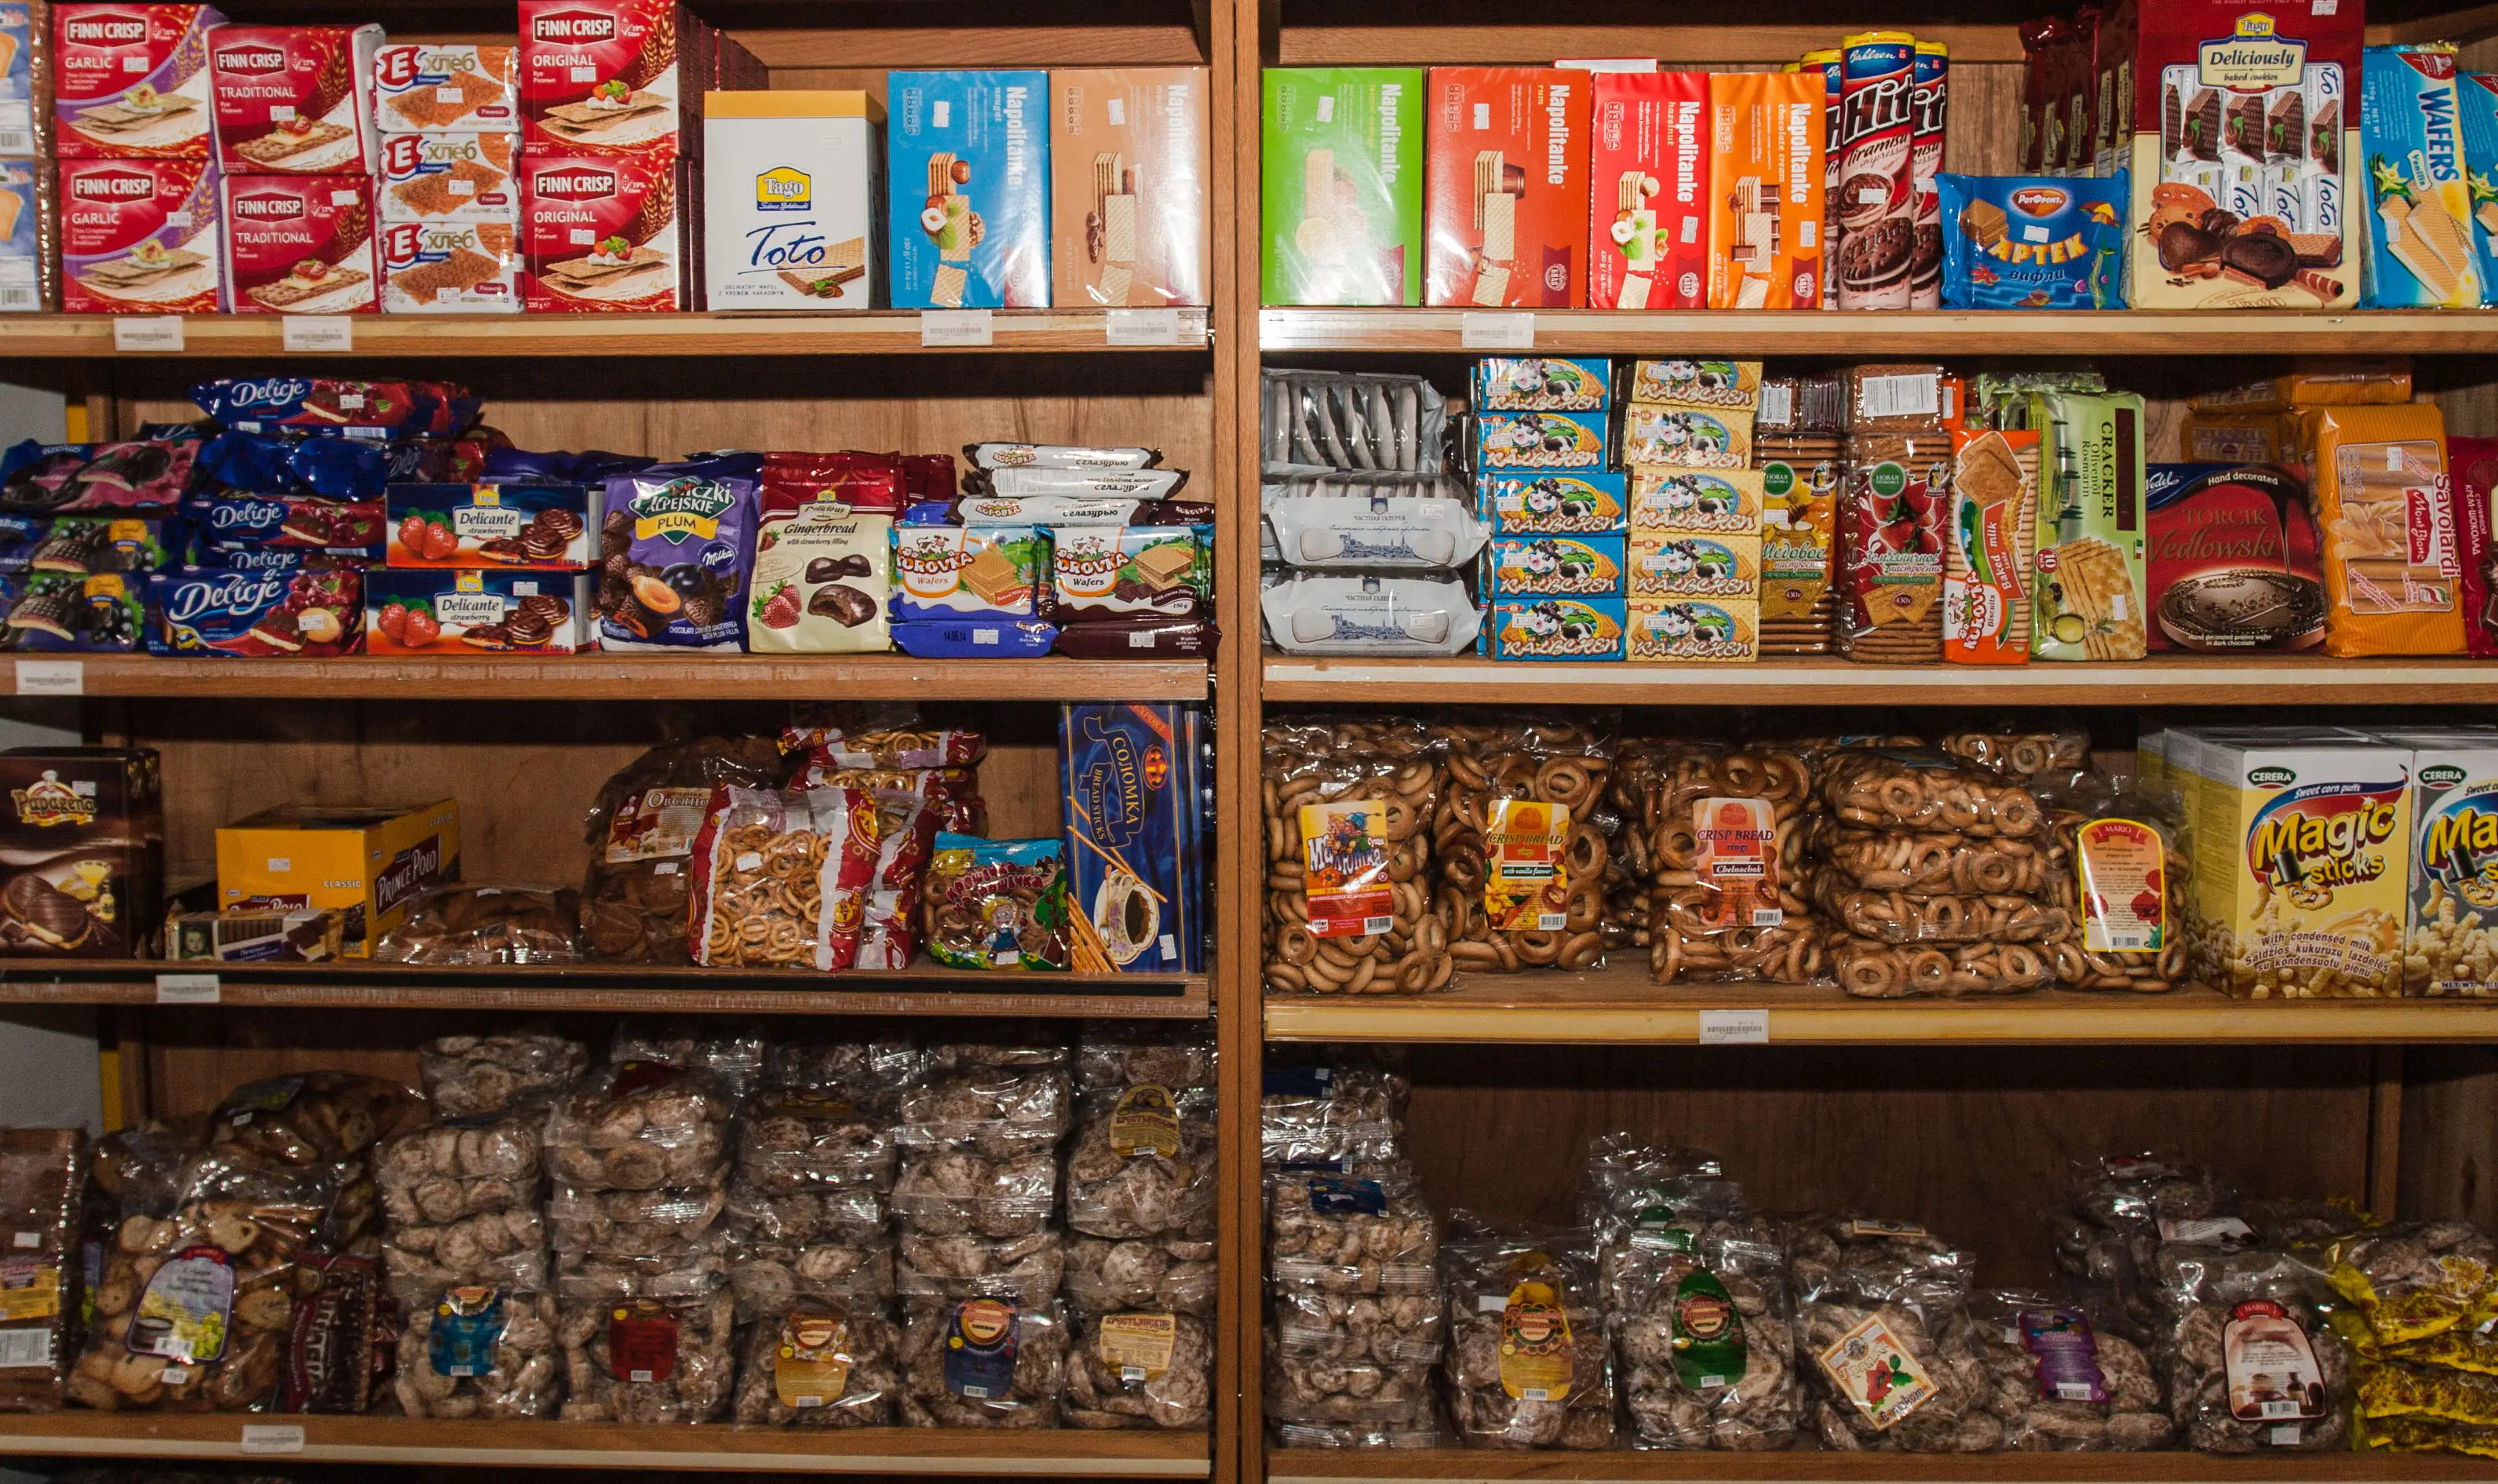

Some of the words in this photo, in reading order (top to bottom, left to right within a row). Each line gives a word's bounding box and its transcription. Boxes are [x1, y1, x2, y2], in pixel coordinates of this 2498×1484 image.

[69, 23, 103, 38] FINN
[104, 24, 144, 38] CRISP
[537, 20, 571, 36] FINN
[572, 20, 612, 36] CRISP
[2242, 20, 2270, 35] Tago
[65, 57, 114, 68] GARLIC
[218, 53, 247, 68] FINN
[249, 53, 283, 68] CRISP
[425, 52, 476, 72] хлеб
[533, 55, 596, 67] ORIGINAL
[1849, 47, 1896, 63] Bahlsen
[2210, 49, 2295, 68] Deliciously
[2224, 73, 2248, 82] baked
[2250, 72, 2277, 81] cookies
[219, 86, 297, 98] TRADITIONAL
[994, 87, 1002, 122] nougat
[1843, 75, 1914, 144] Hit
[1667, 102, 1676, 147] hazelnut
[1777, 104, 1785, 141] chocolate
[1007, 86, 1027, 186] Napolitanke
[1380, 84, 1402, 184] Napolitanke
[1548, 84, 1570, 184] Napolitanke
[2417, 86, 2460, 182] WAFERS
[428, 140, 477, 160] хлеб
[1678, 101, 1700, 202] Napolitanke
[1791, 103, 1812, 204] Napolitanke
[1848, 134, 1908, 166] Tiramisu
[75, 178, 108, 194] FINN
[111, 179, 151, 194] CRISP
[538, 177, 571, 192] FINN
[574, 177, 613, 193] CRISP
[764, 177, 804, 199] Tago
[237, 200, 267, 214] FINN
[268, 200, 301, 214] CRISP
[2018, 194, 2062, 204] РотФронт
[71, 213, 119, 224] GARLIC
[534, 211, 597, 223] ORIGINAL
[235, 232, 313, 244] TRADITIONAL
[427, 230, 475, 249] хлеб
[746, 221, 826, 267] Toto
[1987, 232, 2088, 265] АРТЕК
[2010, 269, 2066, 285] вафли
[232, 379, 306, 407] Delicje
[1487, 393, 1603, 411] KÄLBCHEN
[1639, 383, 1754, 407] KÄLBCHEN
[1485, 450, 1600, 469] KÄLBCHEN
[2082, 440, 2091, 497] Rosmarin
[2091, 443, 2100, 495] Olivenöl
[2102, 421, 2115, 518] CRACKER
[2208, 472, 2231, 486] Hand
[2233, 472, 2279, 485] decorated
[645, 496, 715, 514] ALPEJSKIE
[1069, 510, 1118, 519] глазурью
[2412, 490, 2431, 527] Mont
[212, 502, 282, 529] Delicje
[459, 512, 515, 525] Delicante
[657, 516, 697, 530] PLUM
[1501, 514, 1619, 534] KÄLBCHEN
[1636, 511, 1756, 534] KÄLBCHEN
[2182, 509, 2267, 526] TORCIK
[2434, 472, 2462, 578] Savoiardi
[2465, 483, 2481, 556] КРЕМ-ШОКОЛАД
[468, 527, 507, 536] strawberry
[784, 522, 859, 537] Gingerbread
[1988, 521, 1998, 548] milk
[1763, 541, 1827, 560] Медовое
[2410, 527, 2426, 563] Blanc
[229, 551, 298, 571] Delicje
[702, 549, 735, 567] Milka
[2002, 551, 2011, 570] taste
[2044, 552, 2057, 569] 10
[1889, 563, 1942, 574] настроение
[1991, 554, 2012, 590] Baked
[1073, 578, 1104, 586] Wafers
[1500, 575, 1617, 596] KÄLBCHEN
[1635, 574, 1753, 596] KÄLBCHEN
[170, 574, 283, 621] Delicje
[442, 599, 499, 612] Delicante
[1894, 596, 1913, 604] 430г
[1962, 571, 1986, 651] KOROVKA
[1987, 594, 1996, 628] Biscuits
[1502, 636, 1620, 657] KÄLBCHEN
[1633, 637, 1752, 658] KÄLBCHEN
[1111, 737, 1140, 824] СОЛОМКА
[2251, 771, 2292, 782] CERERA
[2423, 771, 2463, 781] CERERA
[2294, 786, 2321, 800] Sweet
[2321, 784, 2339, 795] corn
[2340, 783, 2361, 793] puffs
[2464, 782, 2489, 797] Sweet
[11, 788, 97, 817] Papagena
[429, 812, 454, 827] CLASSIC
[2105, 825, 2132, 833] MARIO
[1490, 833, 1523, 844] CRISP
[1524, 834, 1564, 845] BREAD
[1697, 830, 1733, 840] CRISP
[1735, 830, 1774, 840] BREAD
[2255, 801, 2397, 872] Magic
[1727, 843, 1749, 853] rings
[377, 867, 411, 901] PRINCE
[412, 848, 437, 877] POLO
[1716, 864, 1762, 874] Chelnochok
[2310, 851, 2387, 885] sticks
[323, 880, 362, 888] CLASSIC
[2261, 933, 2285, 946] With
[2290, 931, 2347, 945] condensed
[2350, 939, 2372, 953] milk
[2245, 946, 2290, 966] Saldžios
[2257, 962, 2270, 972] su
[2275, 957, 2339, 968] kondensuotu
[2343, 962, 2372, 977] pienu
